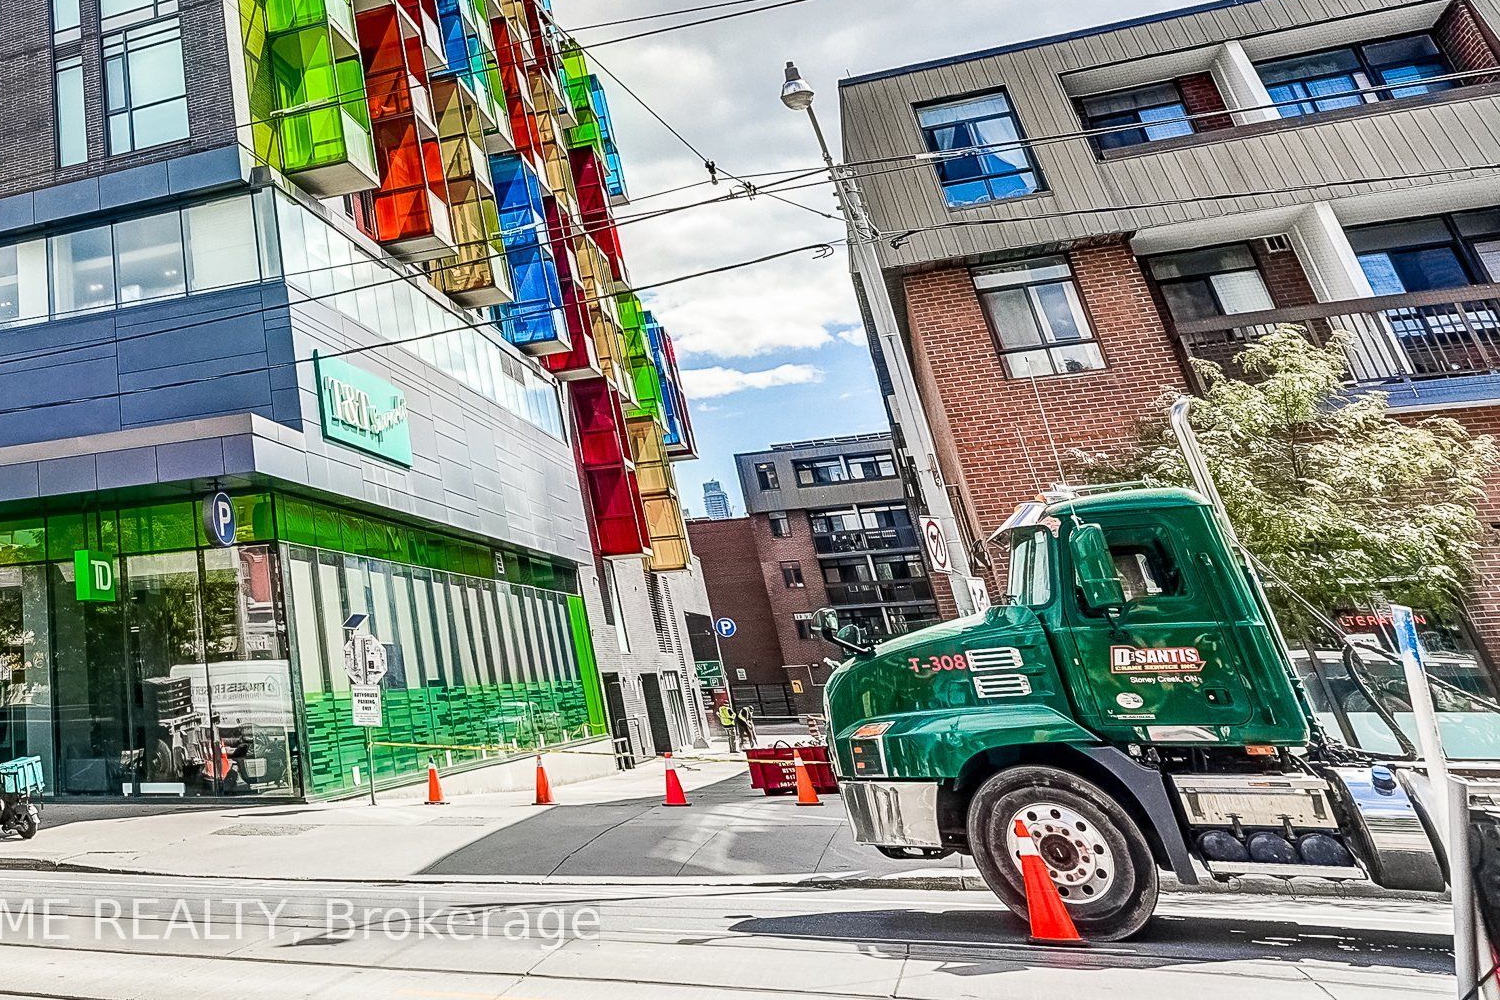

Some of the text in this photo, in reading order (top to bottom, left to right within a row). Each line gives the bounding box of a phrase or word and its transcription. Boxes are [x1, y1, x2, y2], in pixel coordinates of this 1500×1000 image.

[324, 376, 371, 431] T&T
[217, 501, 231, 537] P
[90, 560, 112, 591] TD
[720, 621, 732, 635] P
[908, 653, 967, 673] T-308
[1130, 676, 1156, 685] Stoney
